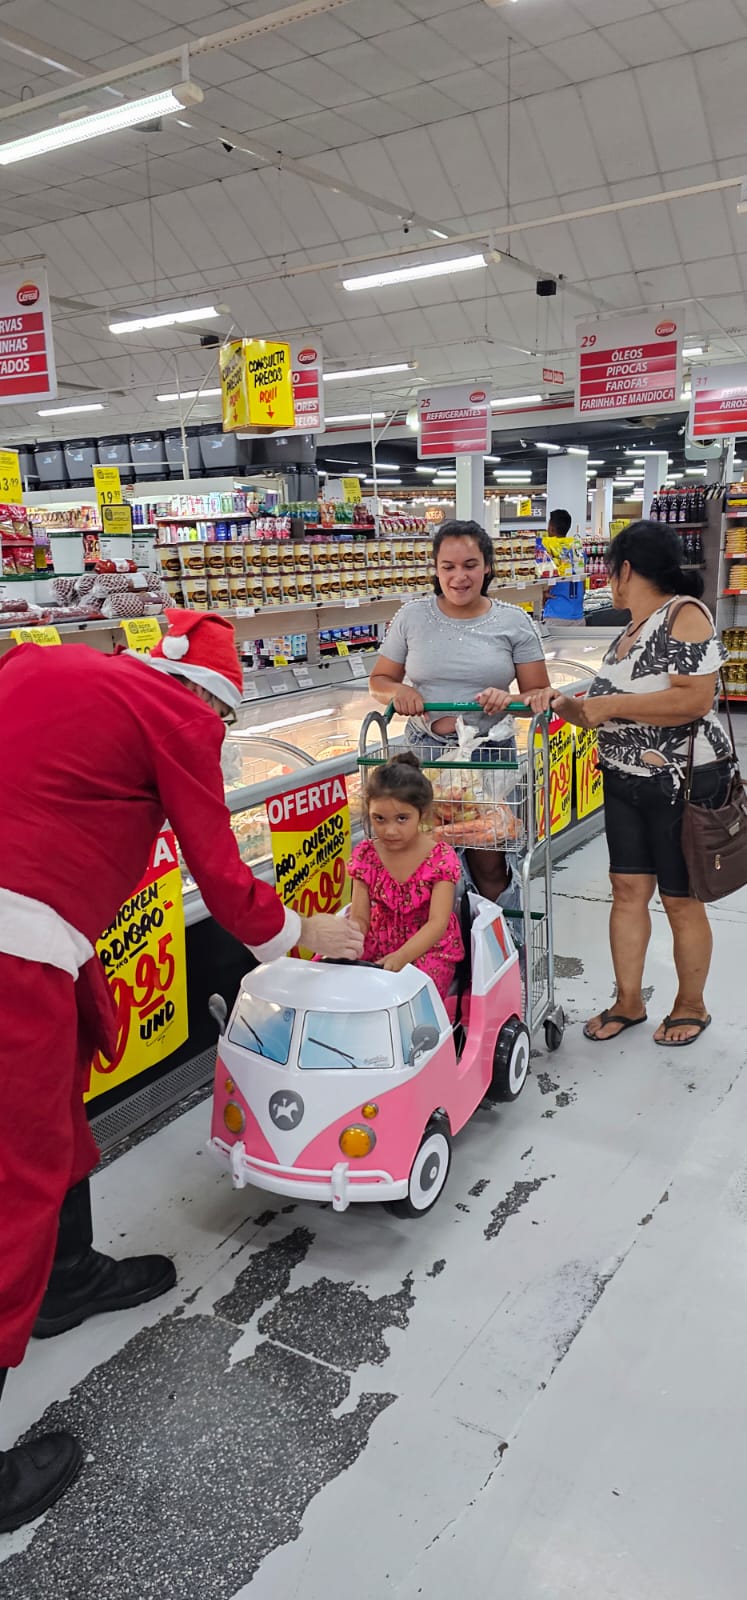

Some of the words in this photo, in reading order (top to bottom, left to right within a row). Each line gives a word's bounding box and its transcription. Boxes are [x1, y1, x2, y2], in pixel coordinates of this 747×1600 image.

[581, 335, 597, 348] 29
[248, 350, 286, 373] CONSULTA
[611, 348, 643, 362] ÓLEOS
[0, 358, 30, 374] ADOS
[606, 362, 648, 377] PIPOCAS
[605, 377, 648, 391] FAROFAS
[420, 399, 431, 408] 25
[581, 396, 614, 410] FARINHA
[616, 394, 626, 406] DE
[627, 388, 674, 405] MANDIOCA
[426, 409, 481, 421] REFRIGERANTES
[267, 779, 346, 825] OFERTA
[302, 814, 343, 857] QUEIJO
[283, 864, 309, 899] FORNO
[316, 831, 345, 865] MINAS
